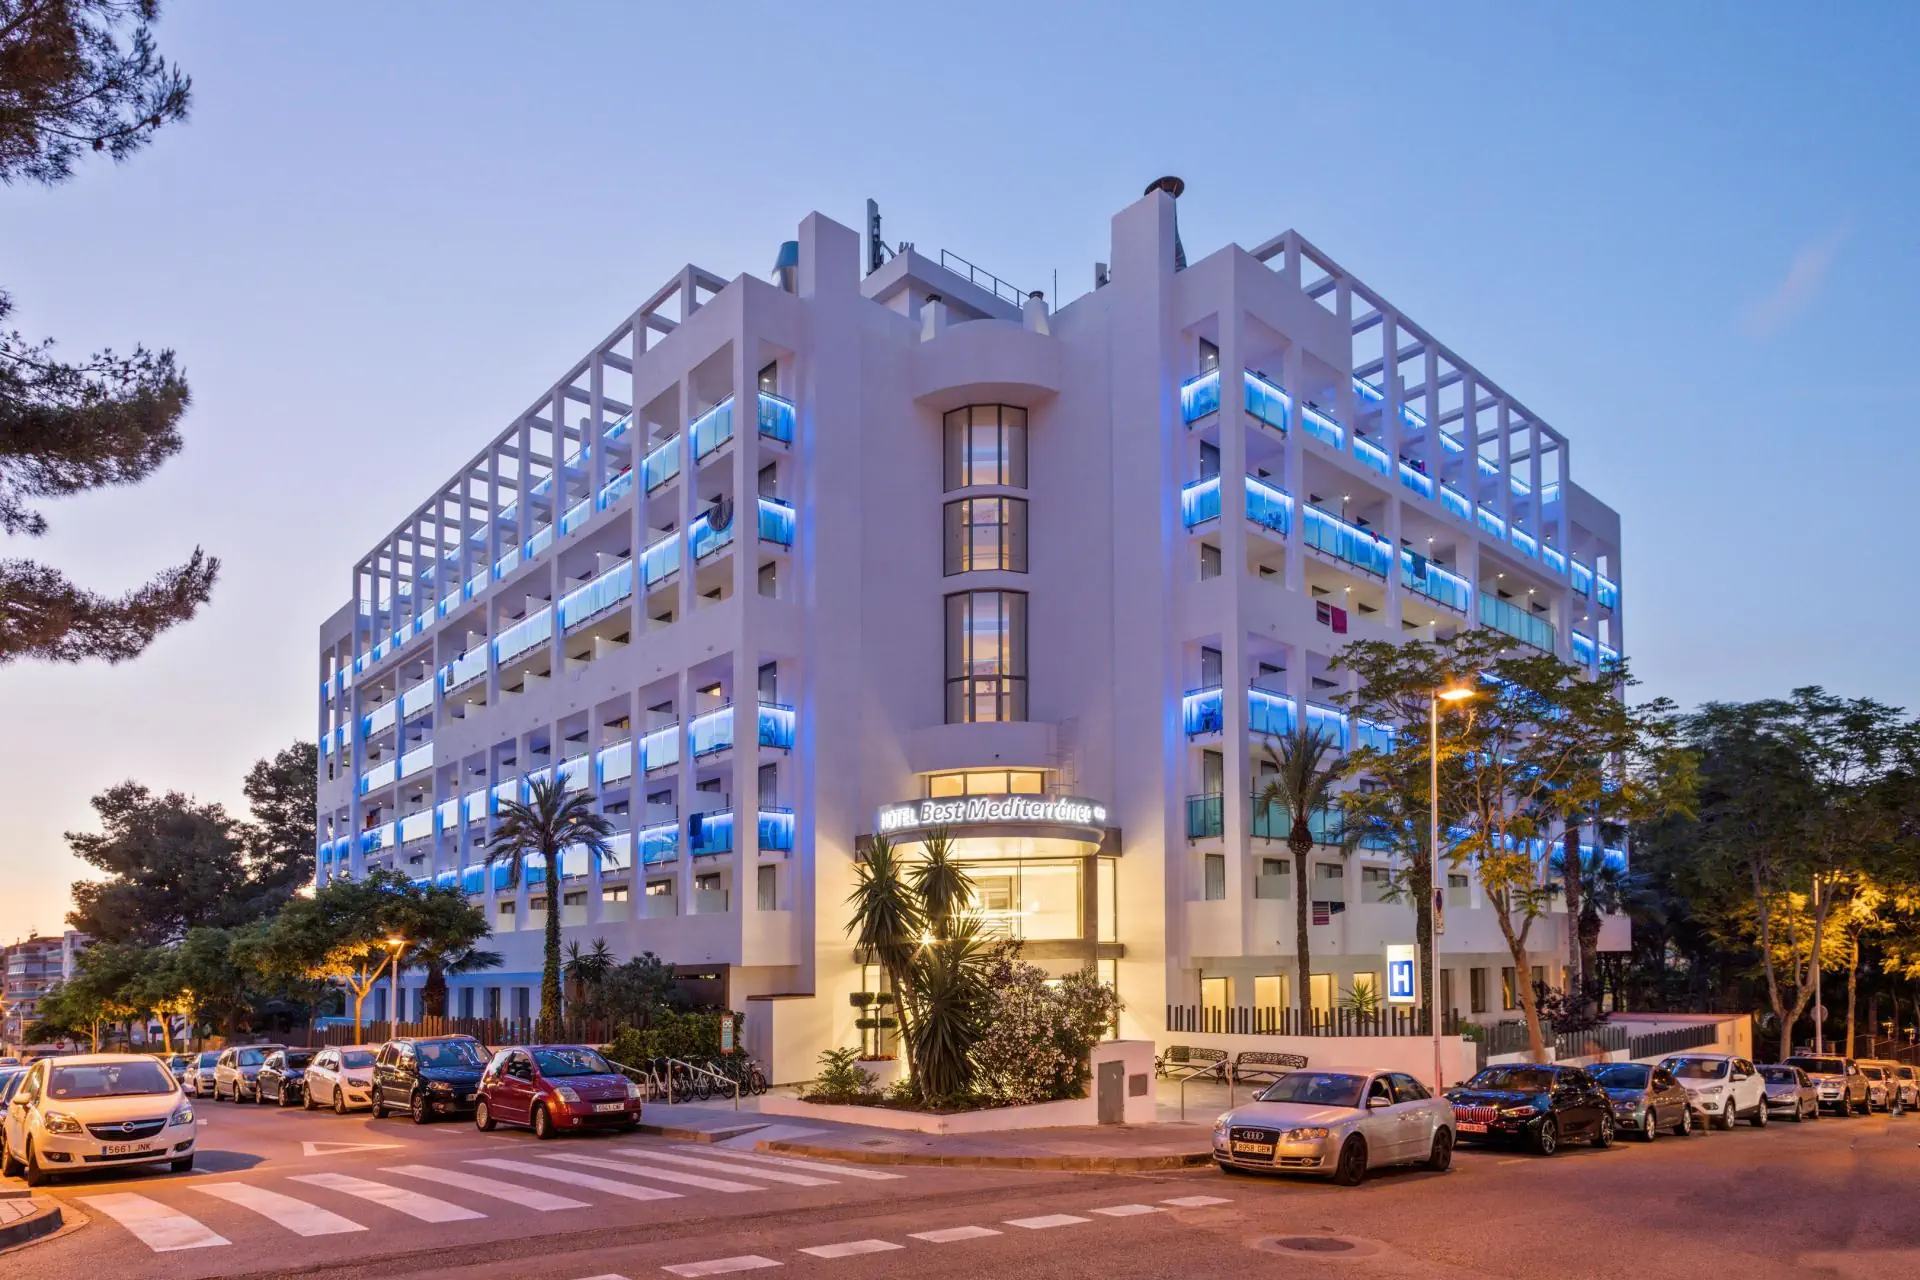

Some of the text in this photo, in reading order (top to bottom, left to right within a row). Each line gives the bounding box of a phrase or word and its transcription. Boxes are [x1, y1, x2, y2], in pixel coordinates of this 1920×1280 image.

[881, 798, 1093, 829] HOTEL Best Mediterráneo
[1393, 965, 1409, 992] H
[109, 1145, 131, 1154] 5661
